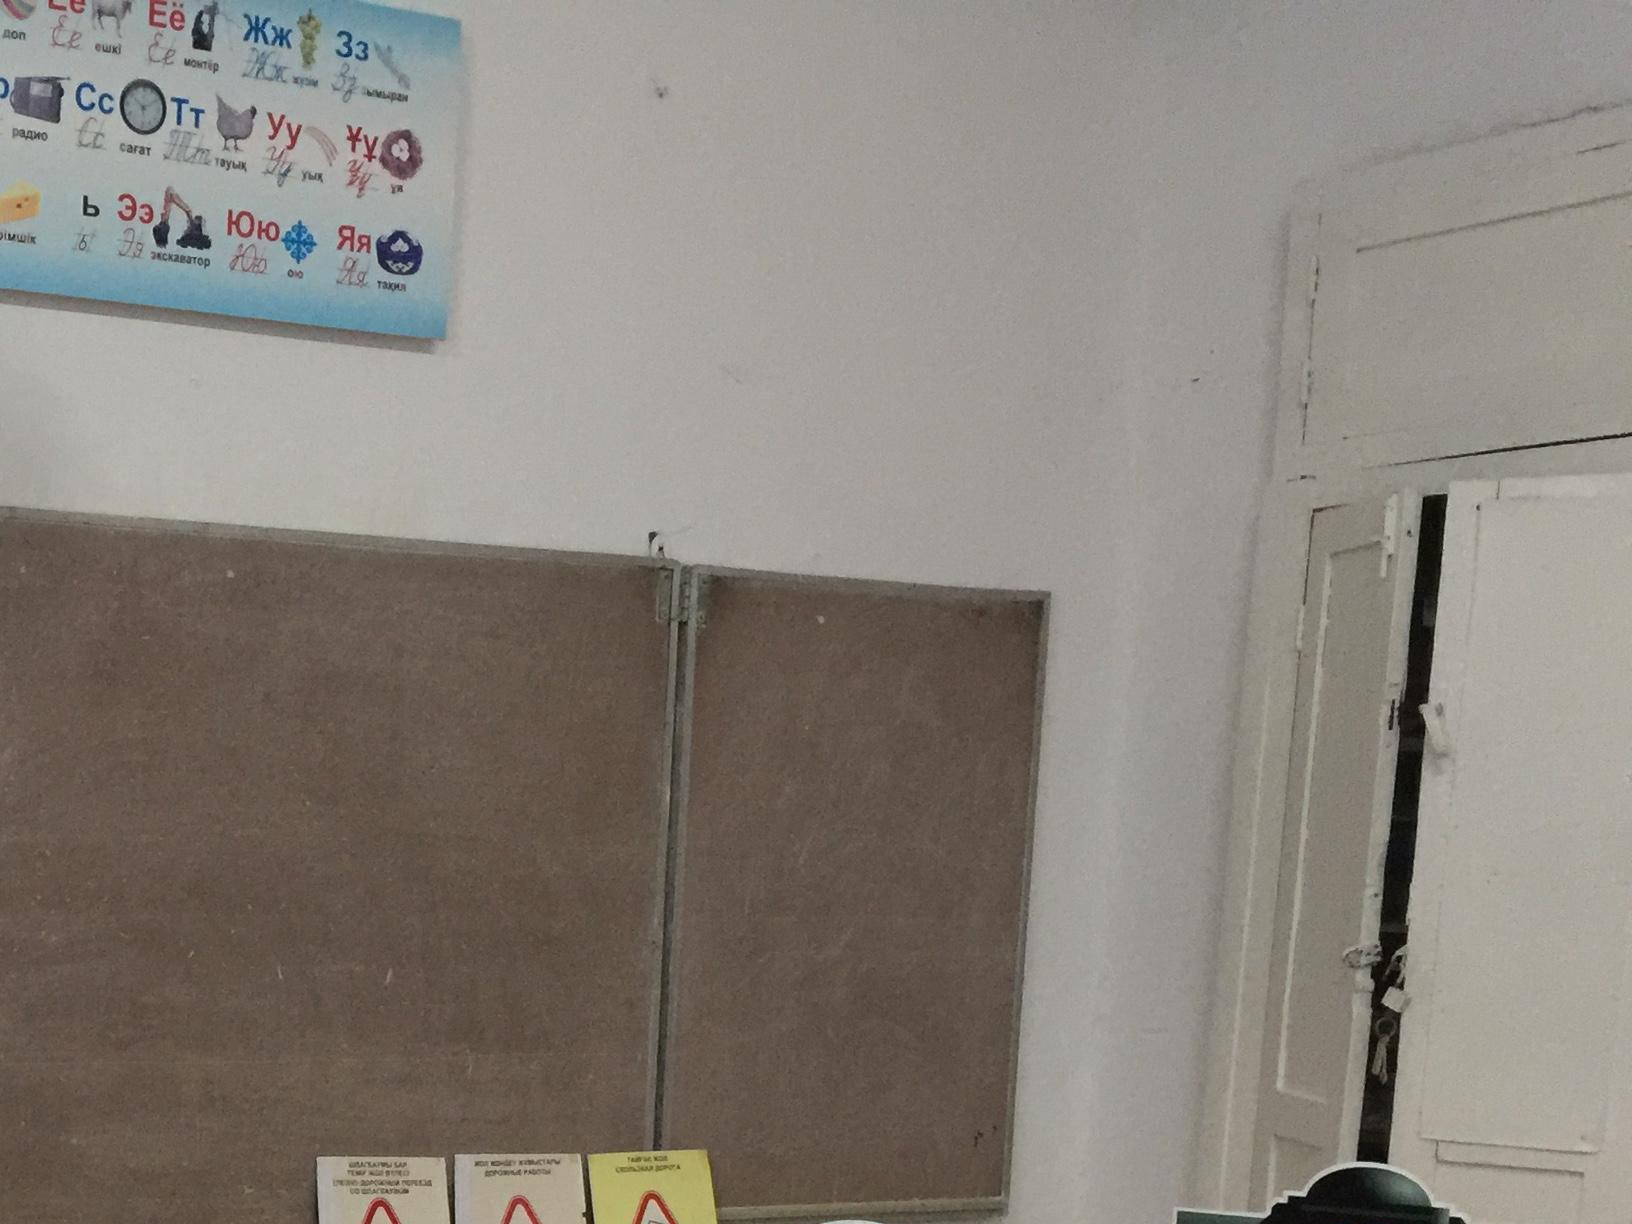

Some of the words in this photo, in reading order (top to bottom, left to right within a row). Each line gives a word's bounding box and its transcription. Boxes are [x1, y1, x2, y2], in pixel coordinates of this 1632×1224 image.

[2, 28, 26, 40] доп
[243, 13, 293, 48] Жж
[336, 30, 369, 61] Зз
[75, 81, 115, 114] Сс
[171, 96, 205, 128] Тт
[12, 127, 49, 141] радио
[267, 111, 302, 150] Уу
[119, 142, 152, 156] сағат
[215, 157, 247, 172] тауық
[117, 193, 154, 224] Ээ
[227, 209, 280, 242] Юю
[337, 225, 372, 254] Яя
[151, 251, 211, 268] экскаватор
